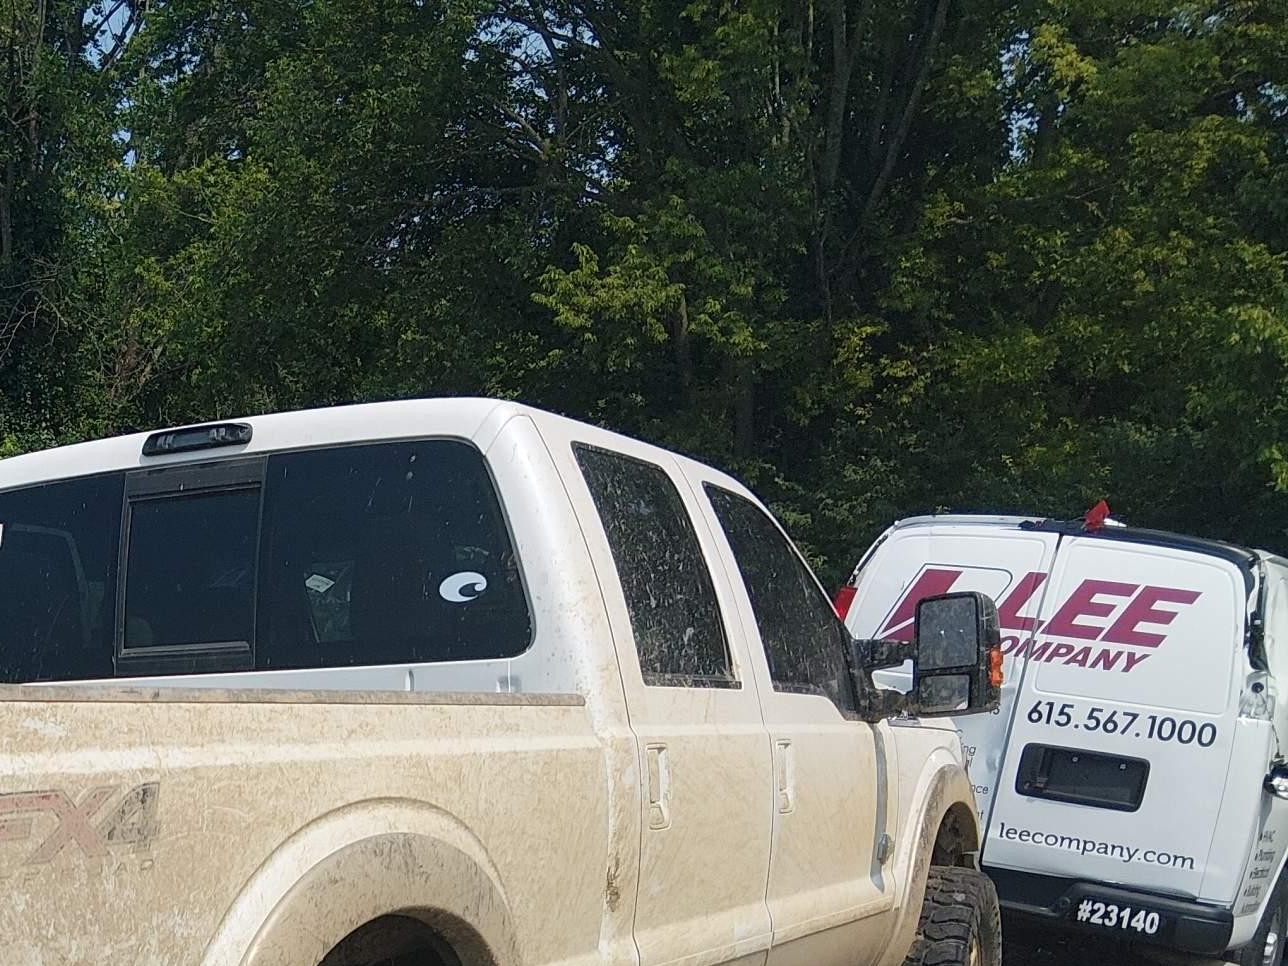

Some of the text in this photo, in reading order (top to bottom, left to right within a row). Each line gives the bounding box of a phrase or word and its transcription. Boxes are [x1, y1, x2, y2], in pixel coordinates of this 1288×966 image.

[998, 571, 1203, 648] LEE
[1000, 635, 1151, 673] OMPANY
[1027, 700, 1217, 747] 615.567.1000
[999, 822, 1195, 869] leecompany.com
[1077, 899, 1160, 935] #23140
